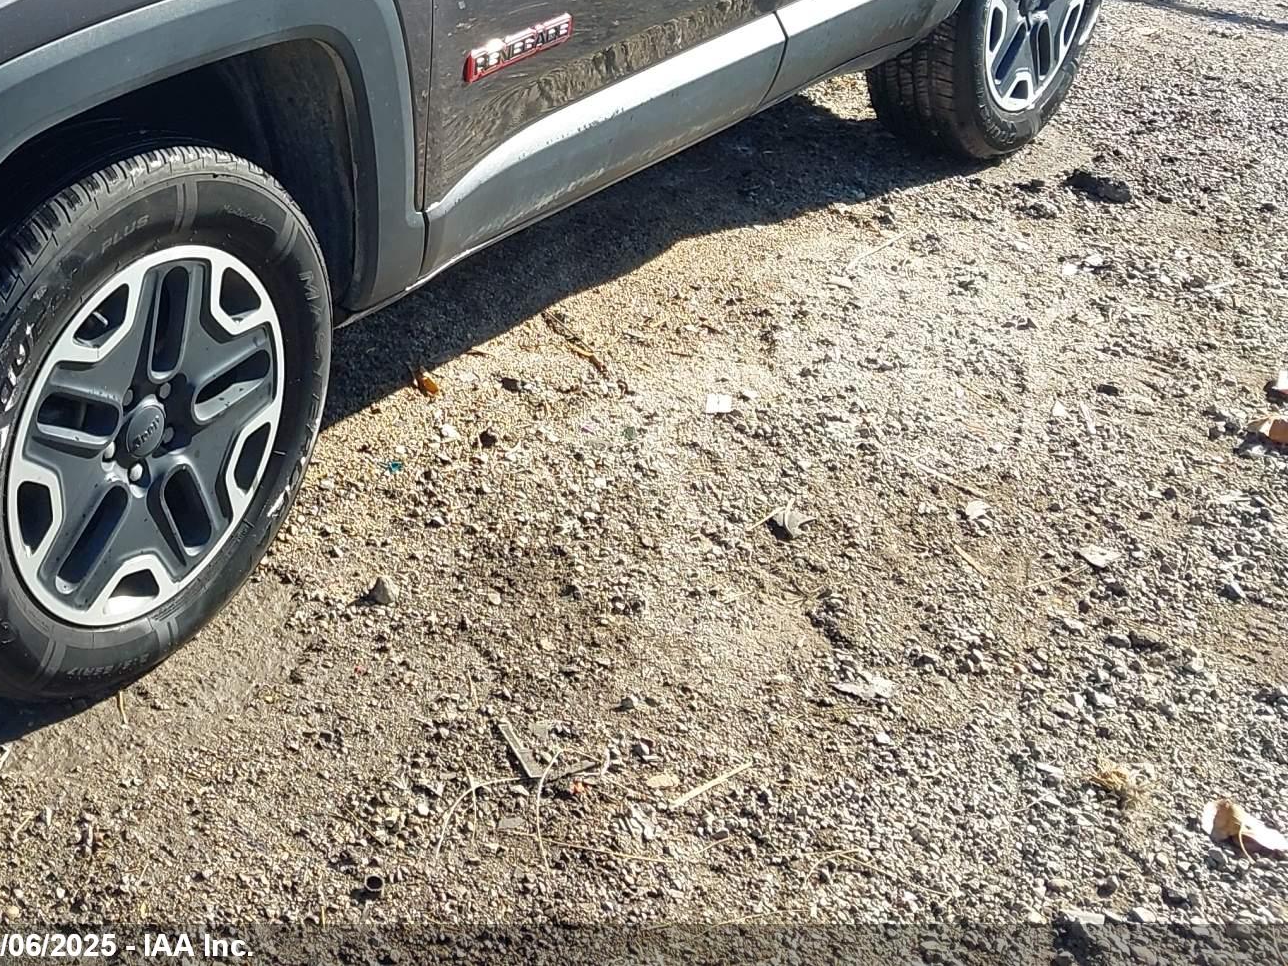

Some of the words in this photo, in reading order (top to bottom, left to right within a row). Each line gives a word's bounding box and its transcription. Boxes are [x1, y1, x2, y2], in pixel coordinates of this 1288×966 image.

[473, 20, 569, 76] RENEGADE
[99, 212, 151, 255] PLUS
[131, 412, 161, 448] Jeep
